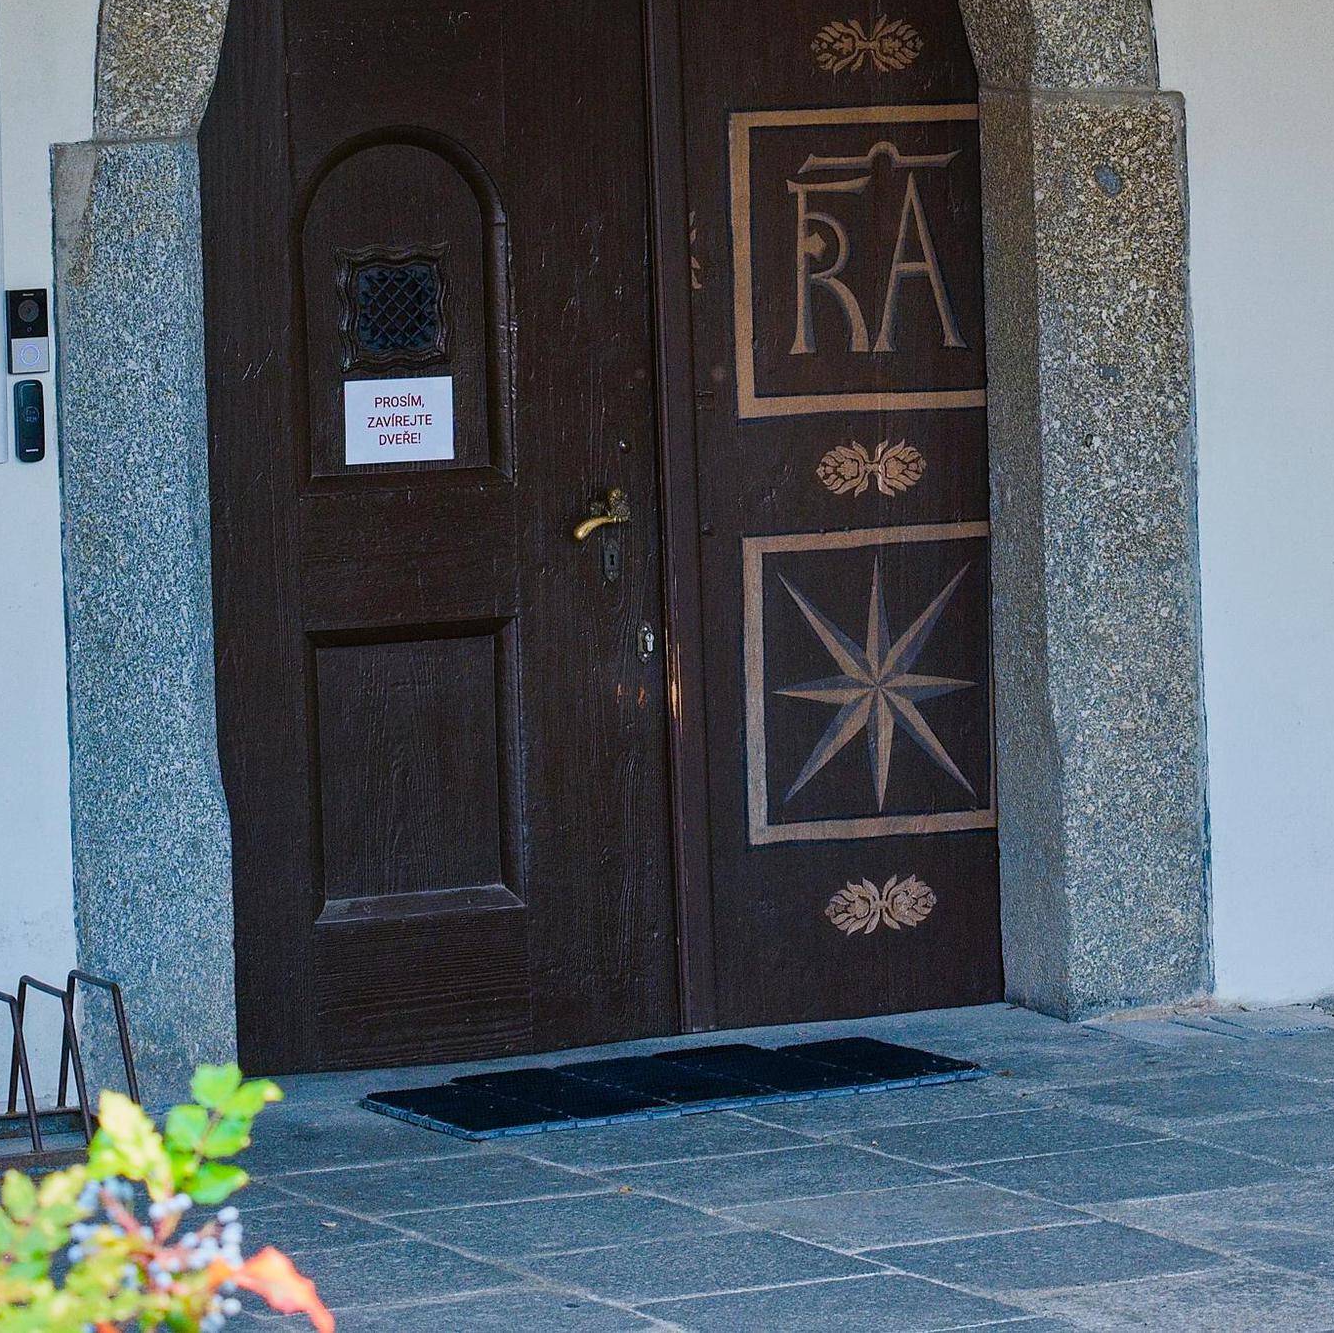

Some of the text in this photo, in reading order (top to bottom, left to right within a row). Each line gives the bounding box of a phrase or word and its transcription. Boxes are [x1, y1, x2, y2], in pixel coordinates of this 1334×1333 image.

[374, 393, 425, 408] PROSÍM,
[367, 413, 433, 429] ZAVÍREJTE
[379, 430, 421, 446] DVEŘE!
